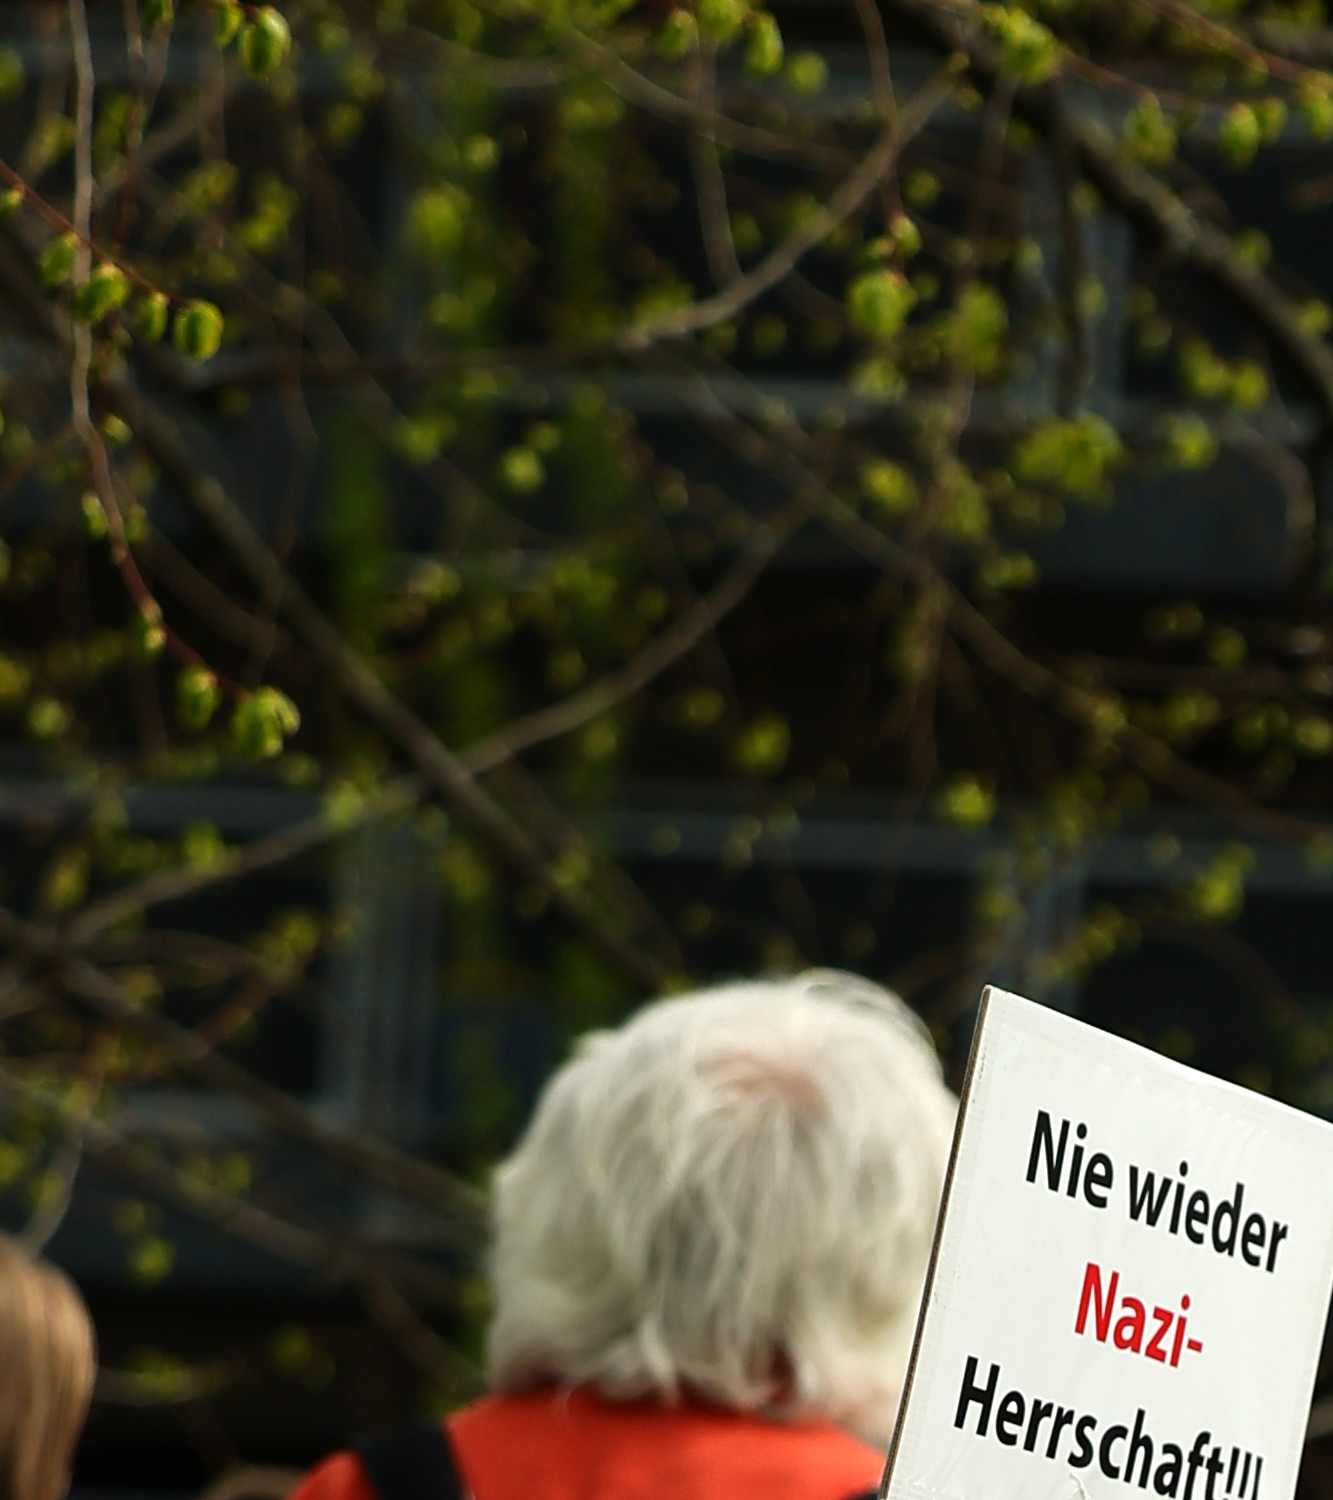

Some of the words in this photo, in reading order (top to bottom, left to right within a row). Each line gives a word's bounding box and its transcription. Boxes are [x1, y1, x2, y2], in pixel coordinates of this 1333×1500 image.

[1025, 1109, 1114, 1209] Nie
[1129, 1160, 1289, 1273] wieder
[1074, 1261, 1204, 1368] Nazi-
